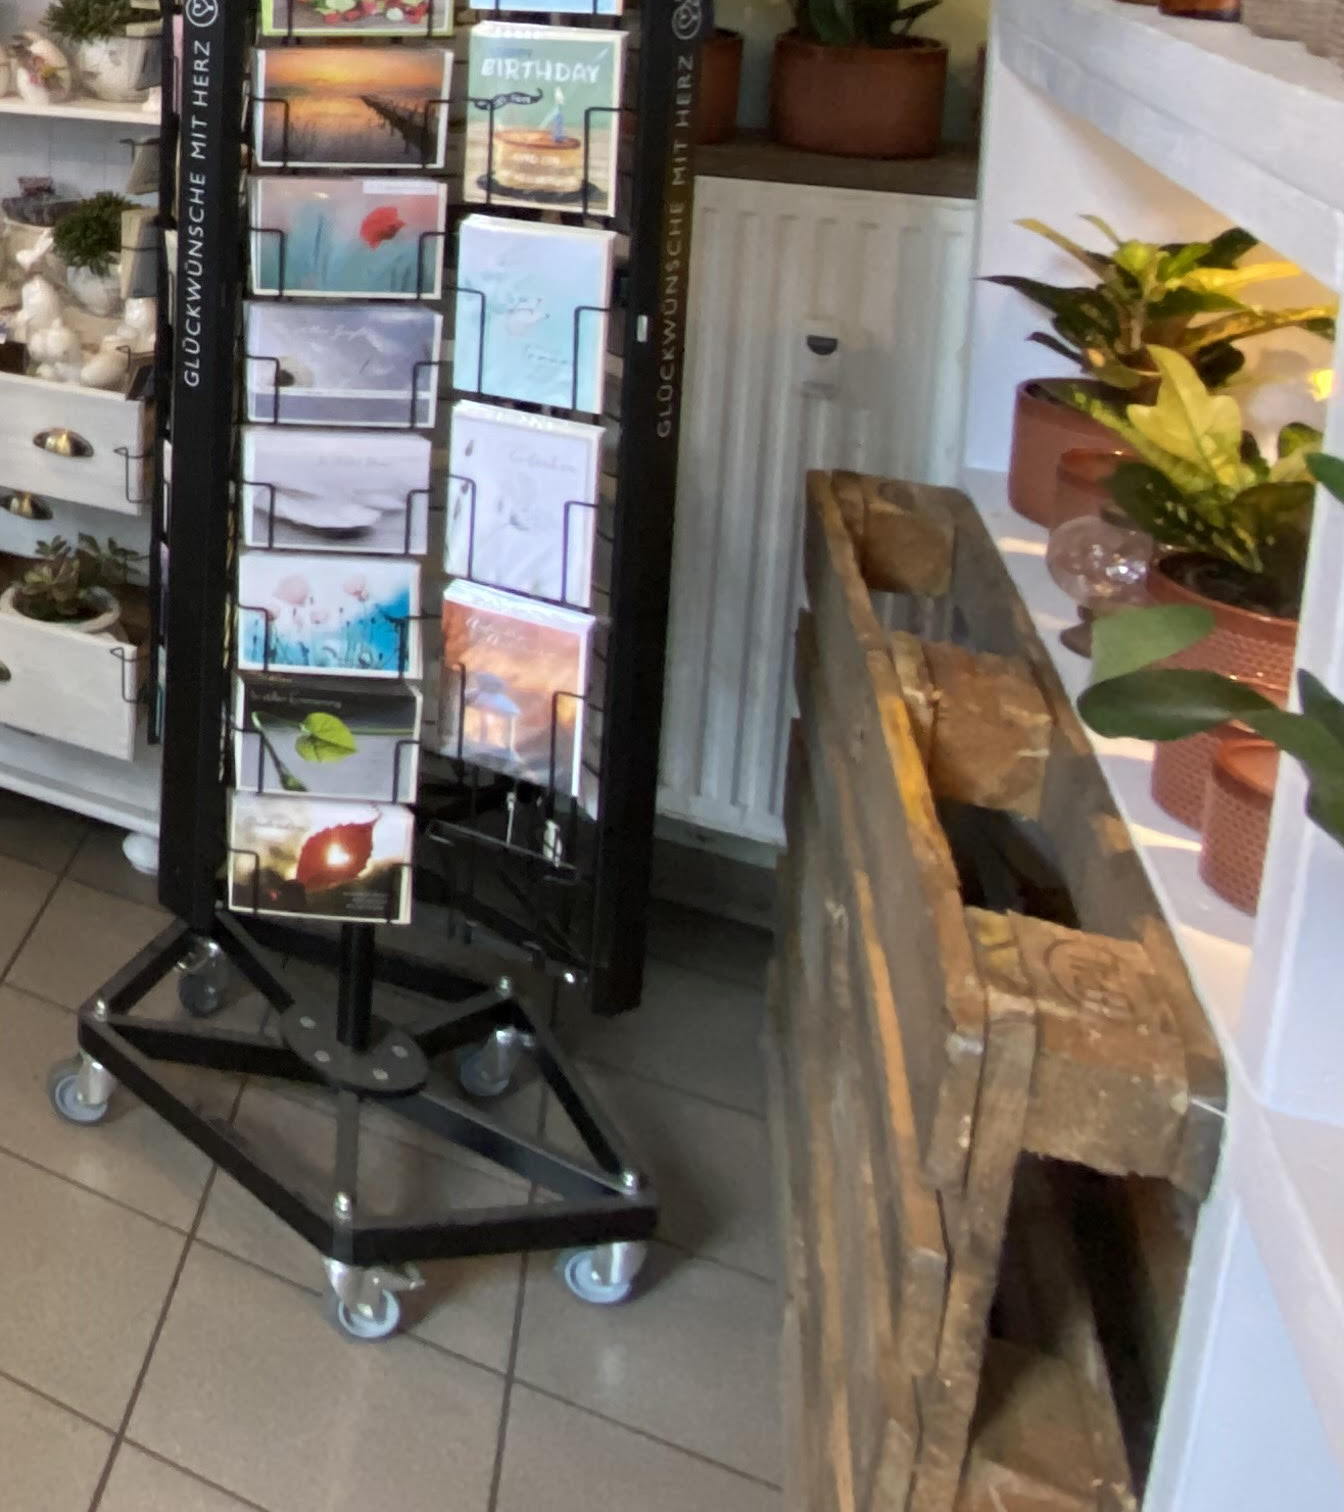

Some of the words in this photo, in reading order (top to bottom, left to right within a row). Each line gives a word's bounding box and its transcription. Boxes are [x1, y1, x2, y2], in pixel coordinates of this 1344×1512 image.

[194, 40, 211, 107] HERZ
[480, 57, 601, 84] BIRTHDAY
[676, 55, 694, 128] HERZ
[191, 115, 209, 159] MIT
[672, 141, 689, 186] MIT
[184, 173, 206, 387] GLÜCKWÜNSCHE
[657, 202, 685, 438] GLÜCKWÜNSCHE
